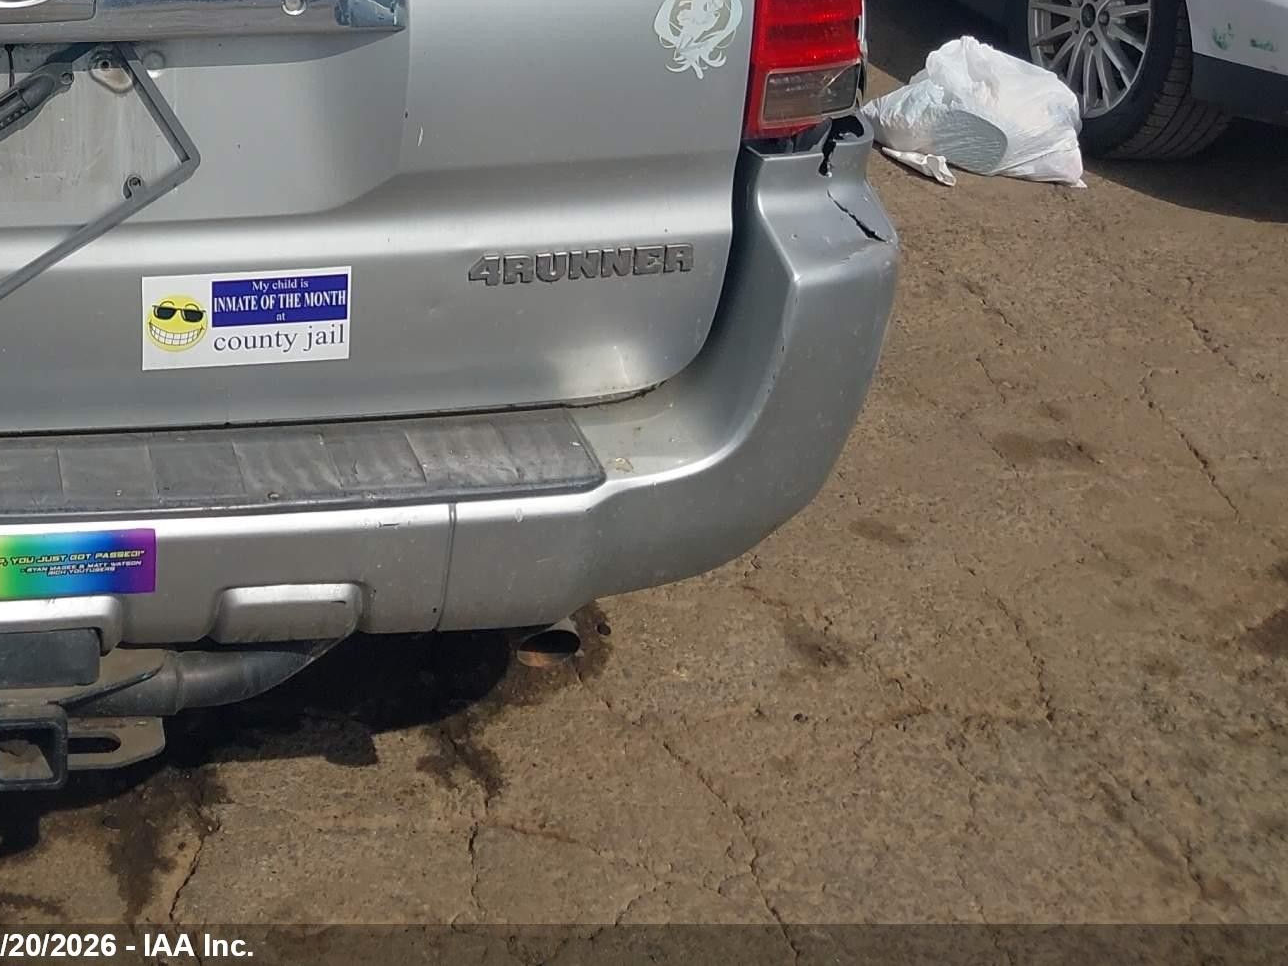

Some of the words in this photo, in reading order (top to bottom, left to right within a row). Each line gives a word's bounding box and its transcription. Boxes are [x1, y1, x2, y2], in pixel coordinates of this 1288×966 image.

[468, 243, 694, 286] 4RUNNER
[252, 281, 268, 293] My
[272, 279, 298, 290] child
[300, 279, 309, 289] is
[213, 295, 258, 313] INMATE
[260, 294, 276, 311] OF
[278, 292, 302, 309] THE
[303, 290, 347, 307] MONTH
[276, 312, 286, 322] at
[213, 328, 298, 353] county
[303, 323, 345, 352] jail
[12, 557, 34, 565] YOU
[37, 555, 67, 564] JUST
[70, 553, 92, 561] GOT
